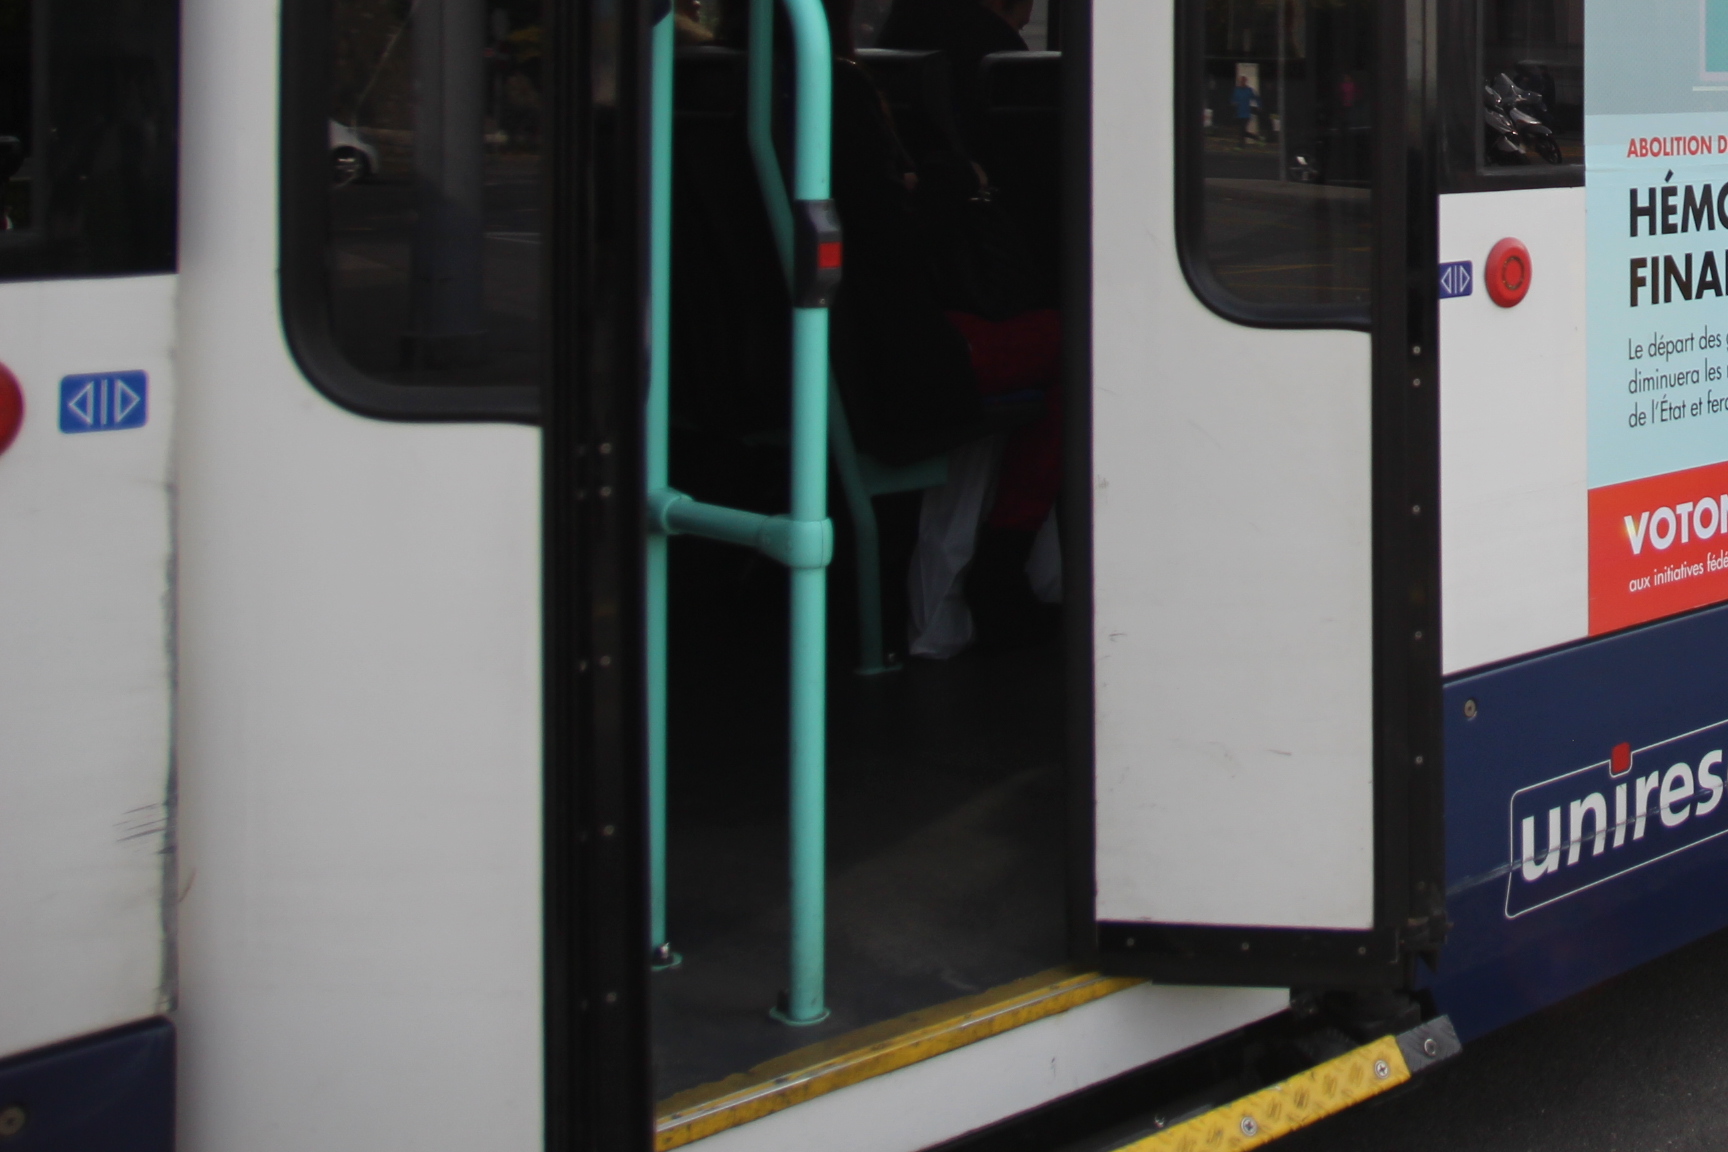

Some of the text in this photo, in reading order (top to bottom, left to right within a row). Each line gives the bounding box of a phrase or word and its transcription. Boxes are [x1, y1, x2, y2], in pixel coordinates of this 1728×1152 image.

[1627, 135, 1712, 158] ABOLITION
[1628, 338, 1643, 360] Le
[1648, 332, 1695, 362] départ
[1699, 325, 1722, 350] des
[1628, 368, 1700, 394] diminuera
[1704, 358, 1722, 382] les
[1628, 402, 1647, 428] de
[1651, 394, 1686, 424] l'État
[1690, 397, 1702, 416] et
[1629, 575, 1651, 593] aux
[1653, 560, 1704, 586] initiatives
